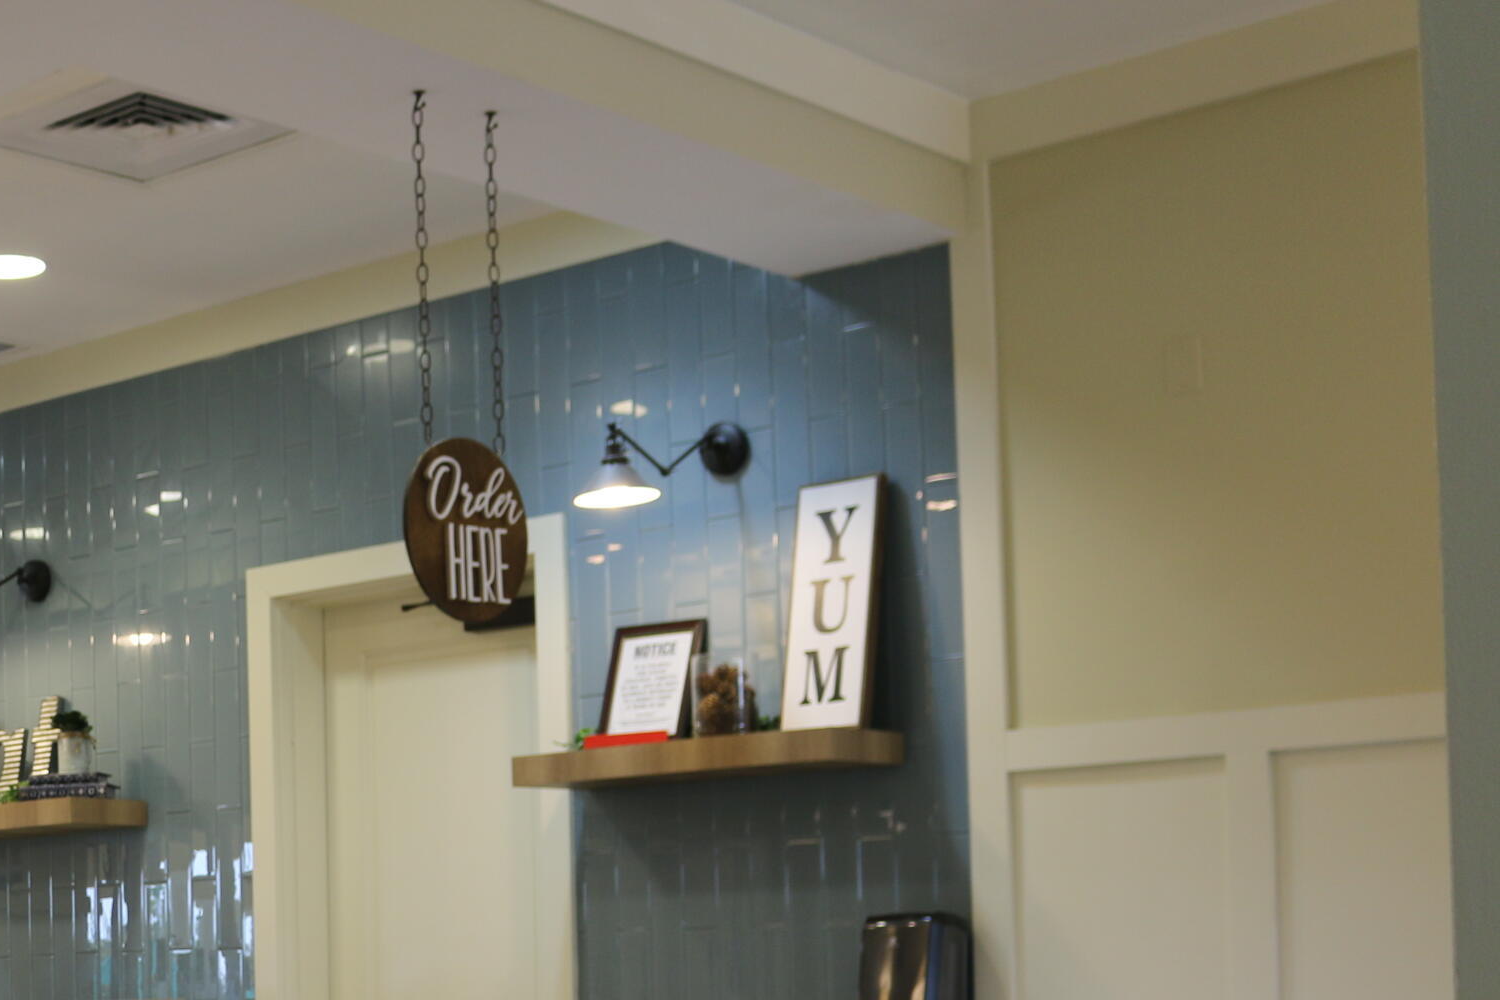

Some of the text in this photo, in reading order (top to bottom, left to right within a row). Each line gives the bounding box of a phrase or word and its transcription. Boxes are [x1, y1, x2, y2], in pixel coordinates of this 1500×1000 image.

[426, 455, 523, 525] Order
[448, 522, 512, 604] HERE
[799, 505, 860, 706] YUM
[634, 642, 676, 658] NOTICE
